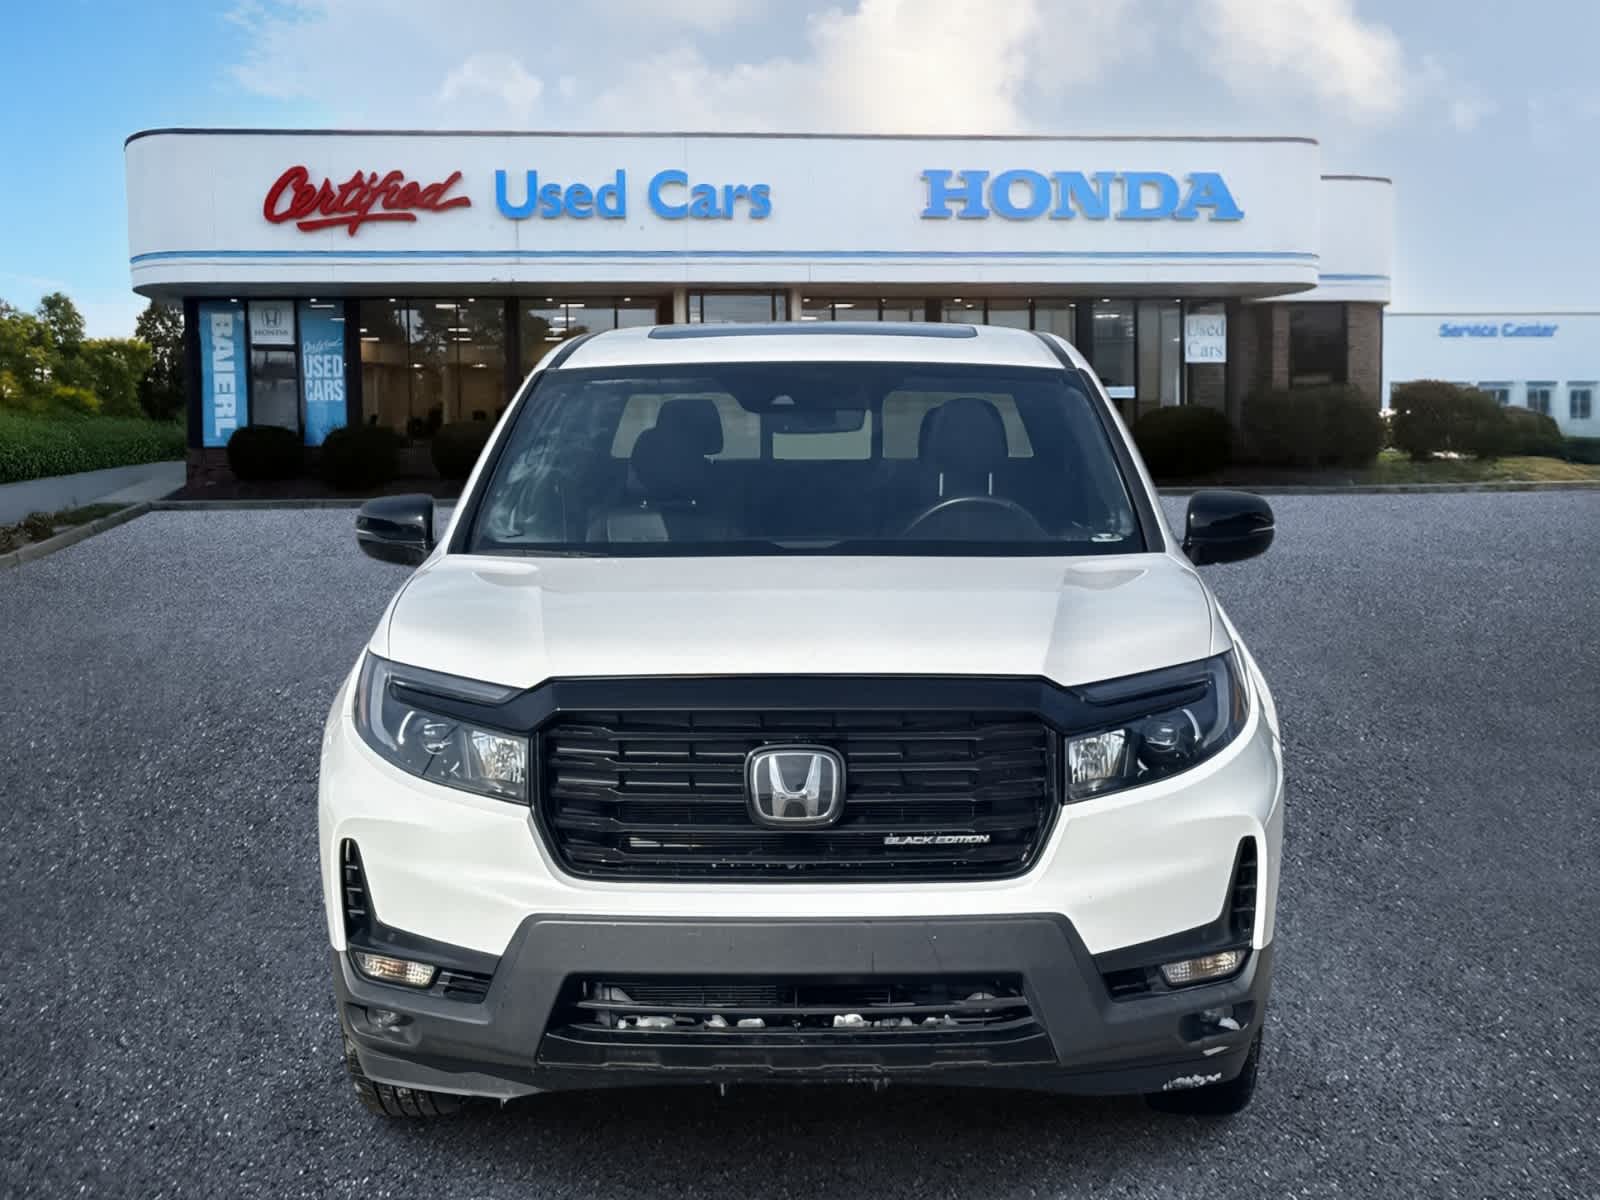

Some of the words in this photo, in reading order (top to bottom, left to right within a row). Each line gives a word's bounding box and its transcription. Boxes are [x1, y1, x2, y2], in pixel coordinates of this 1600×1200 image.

[263, 165, 471, 237] Certified
[495, 169, 627, 220] Used
[647, 169, 772, 220] Cars
[920, 169, 1245, 221] HONDA
[254, 328, 289, 336] HONDA
[1187, 319, 1225, 337] Used
[1439, 323, 1498, 337] Service
[1501, 322, 1558, 337] Center
[1187, 341, 1224, 357] Cars
[210, 313, 238, 437] BAIERL
[303, 354, 343, 378] USED
[304, 379, 344, 401] CARS
[884, 836, 934, 845] BLACK
[935, 834, 990, 844] EDITION
